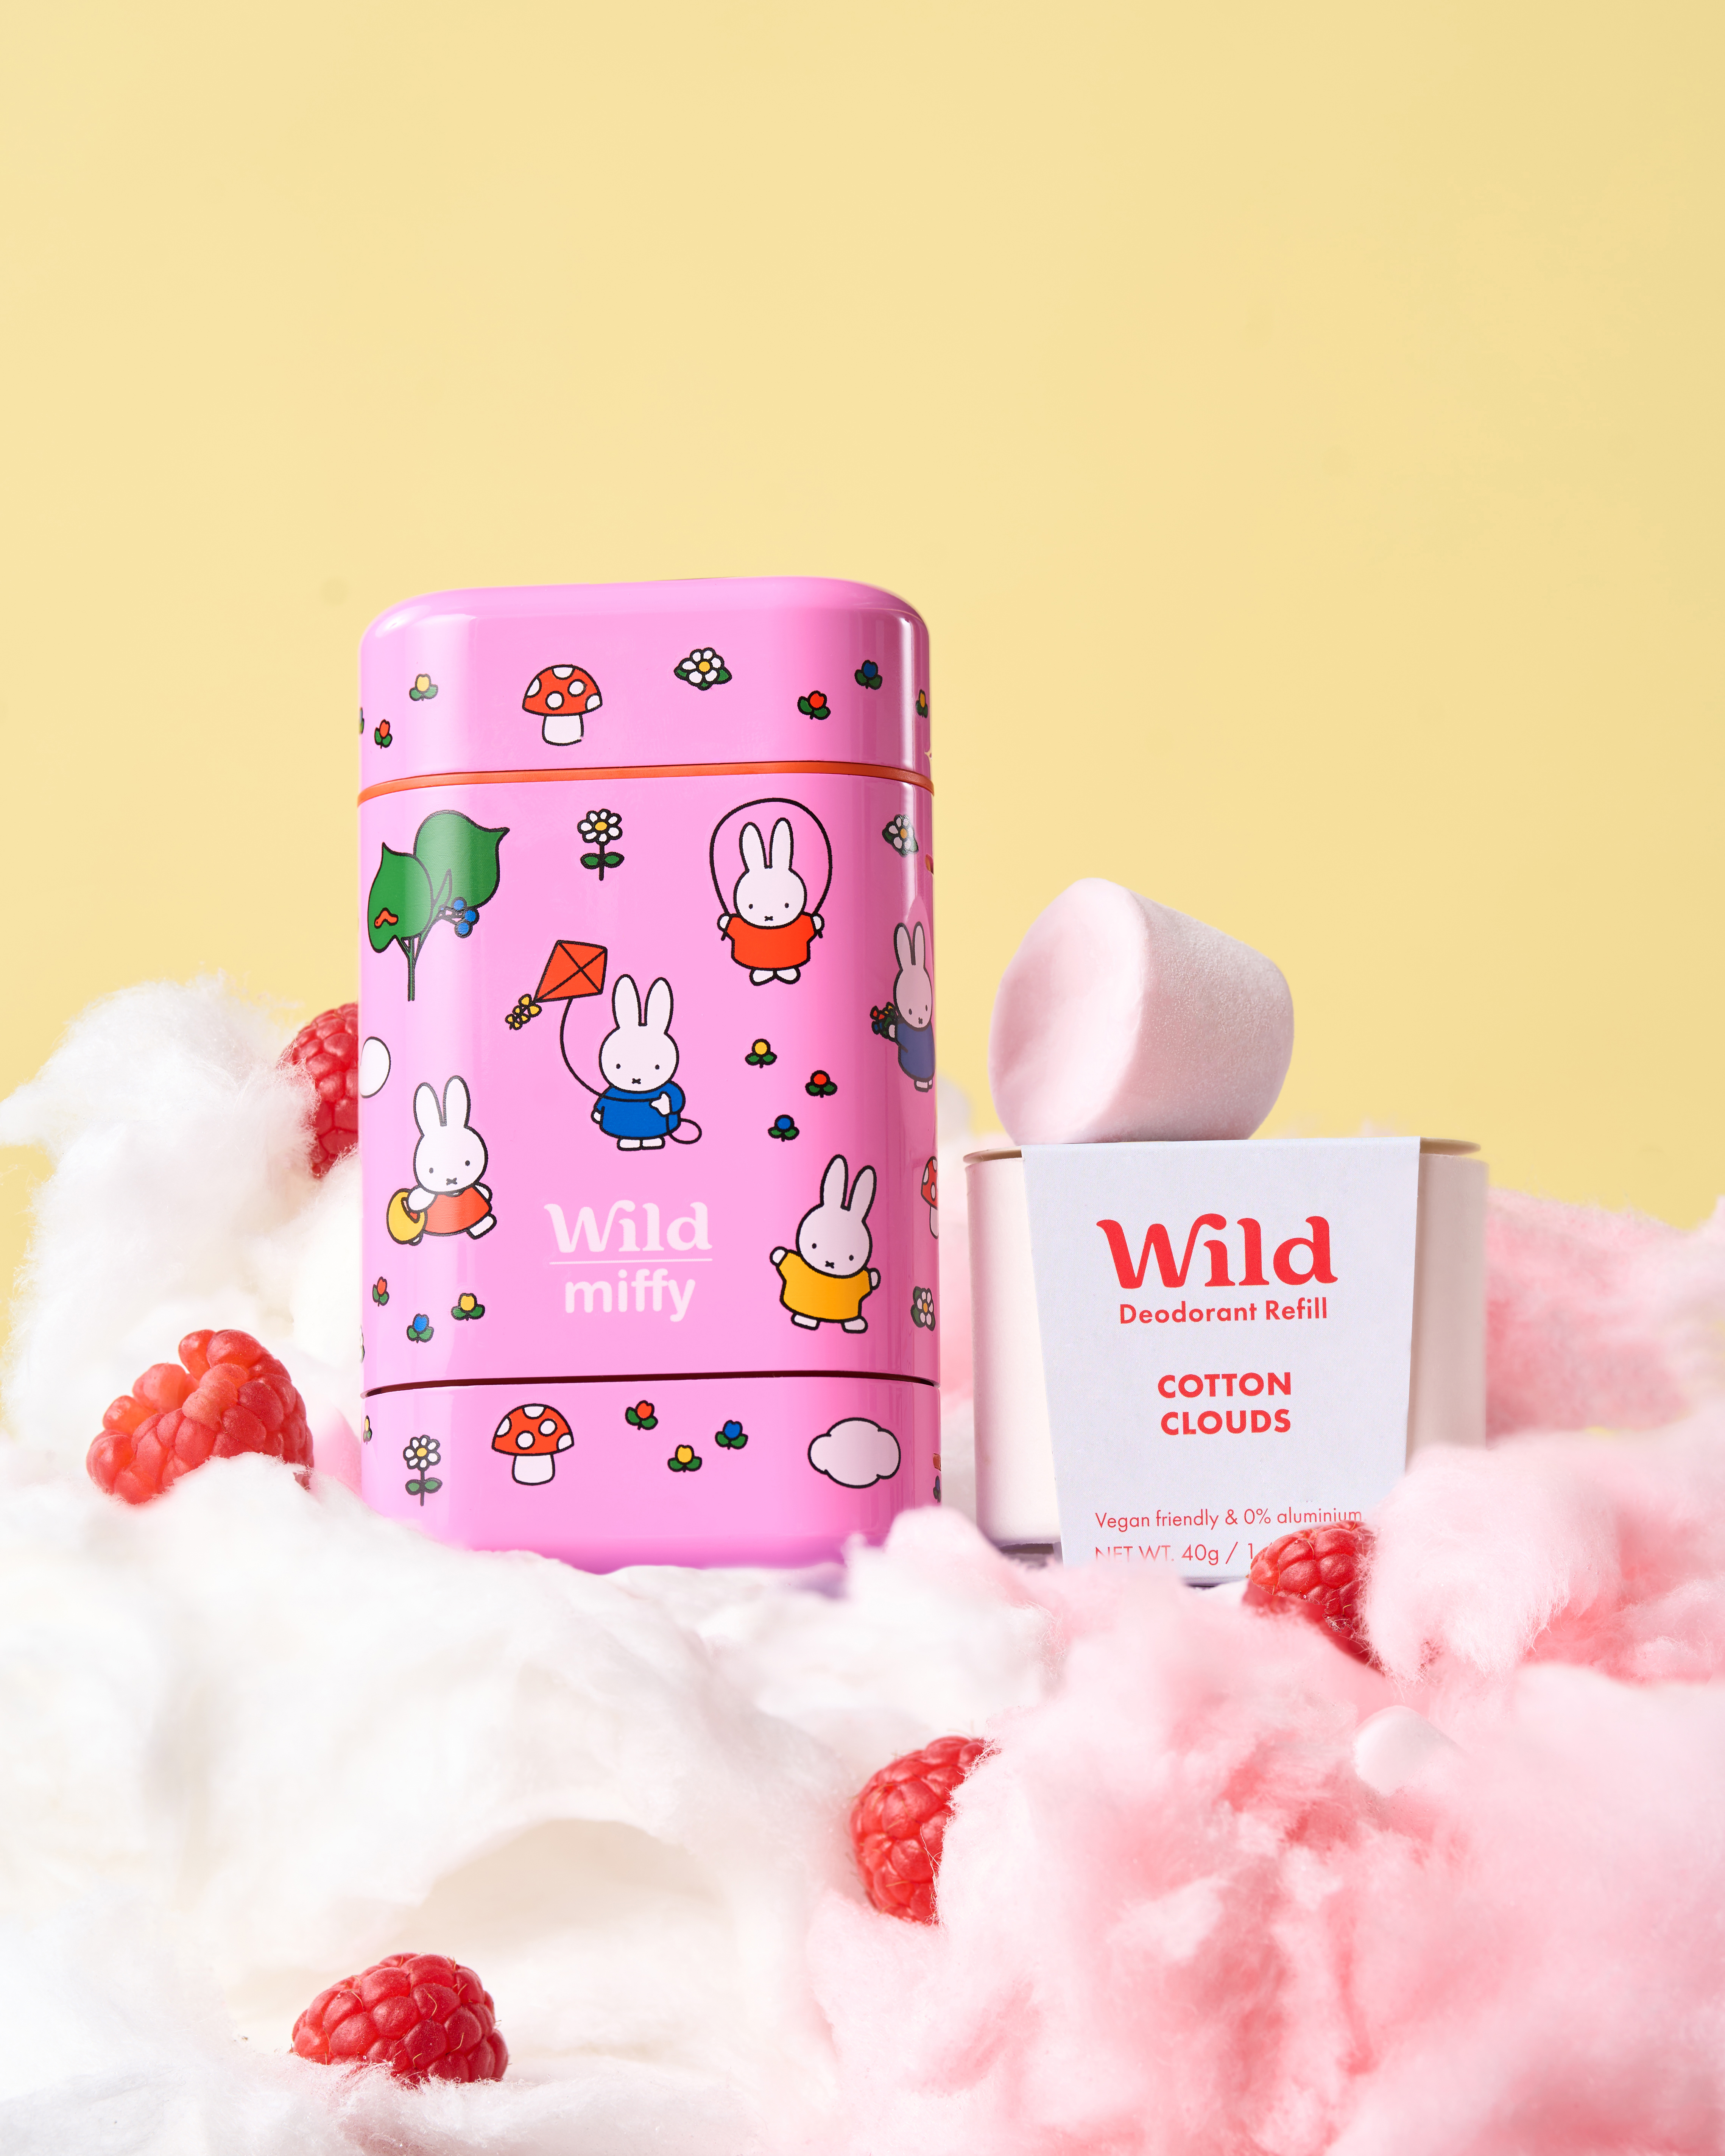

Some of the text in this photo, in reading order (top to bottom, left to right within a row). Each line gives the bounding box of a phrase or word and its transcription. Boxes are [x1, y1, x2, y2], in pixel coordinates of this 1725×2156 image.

[544, 1200, 712, 1253] Wild
[1096, 1214, 1338, 1289] Wild
[565, 1268, 696, 1322] miffy
[1120, 1297, 1327, 1324] Deodorant Refill
[1158, 1372, 1291, 1399] COTTON
[1161, 1409, 1291, 1436] CLOUDS
[1095, 1513, 1150, 1532] Vegan
[1156, 1509, 1219, 1530] friendly
[1225, 1510, 1238, 1525] &
[1244, 1509, 1272, 1525] 0%
[1095, 1546, 1133, 1562] NET
[1139, 1545, 1174, 1562] WT.
[1182, 1544, 1219, 1566] 40g
[1225, 1542, 1238, 1564] /
